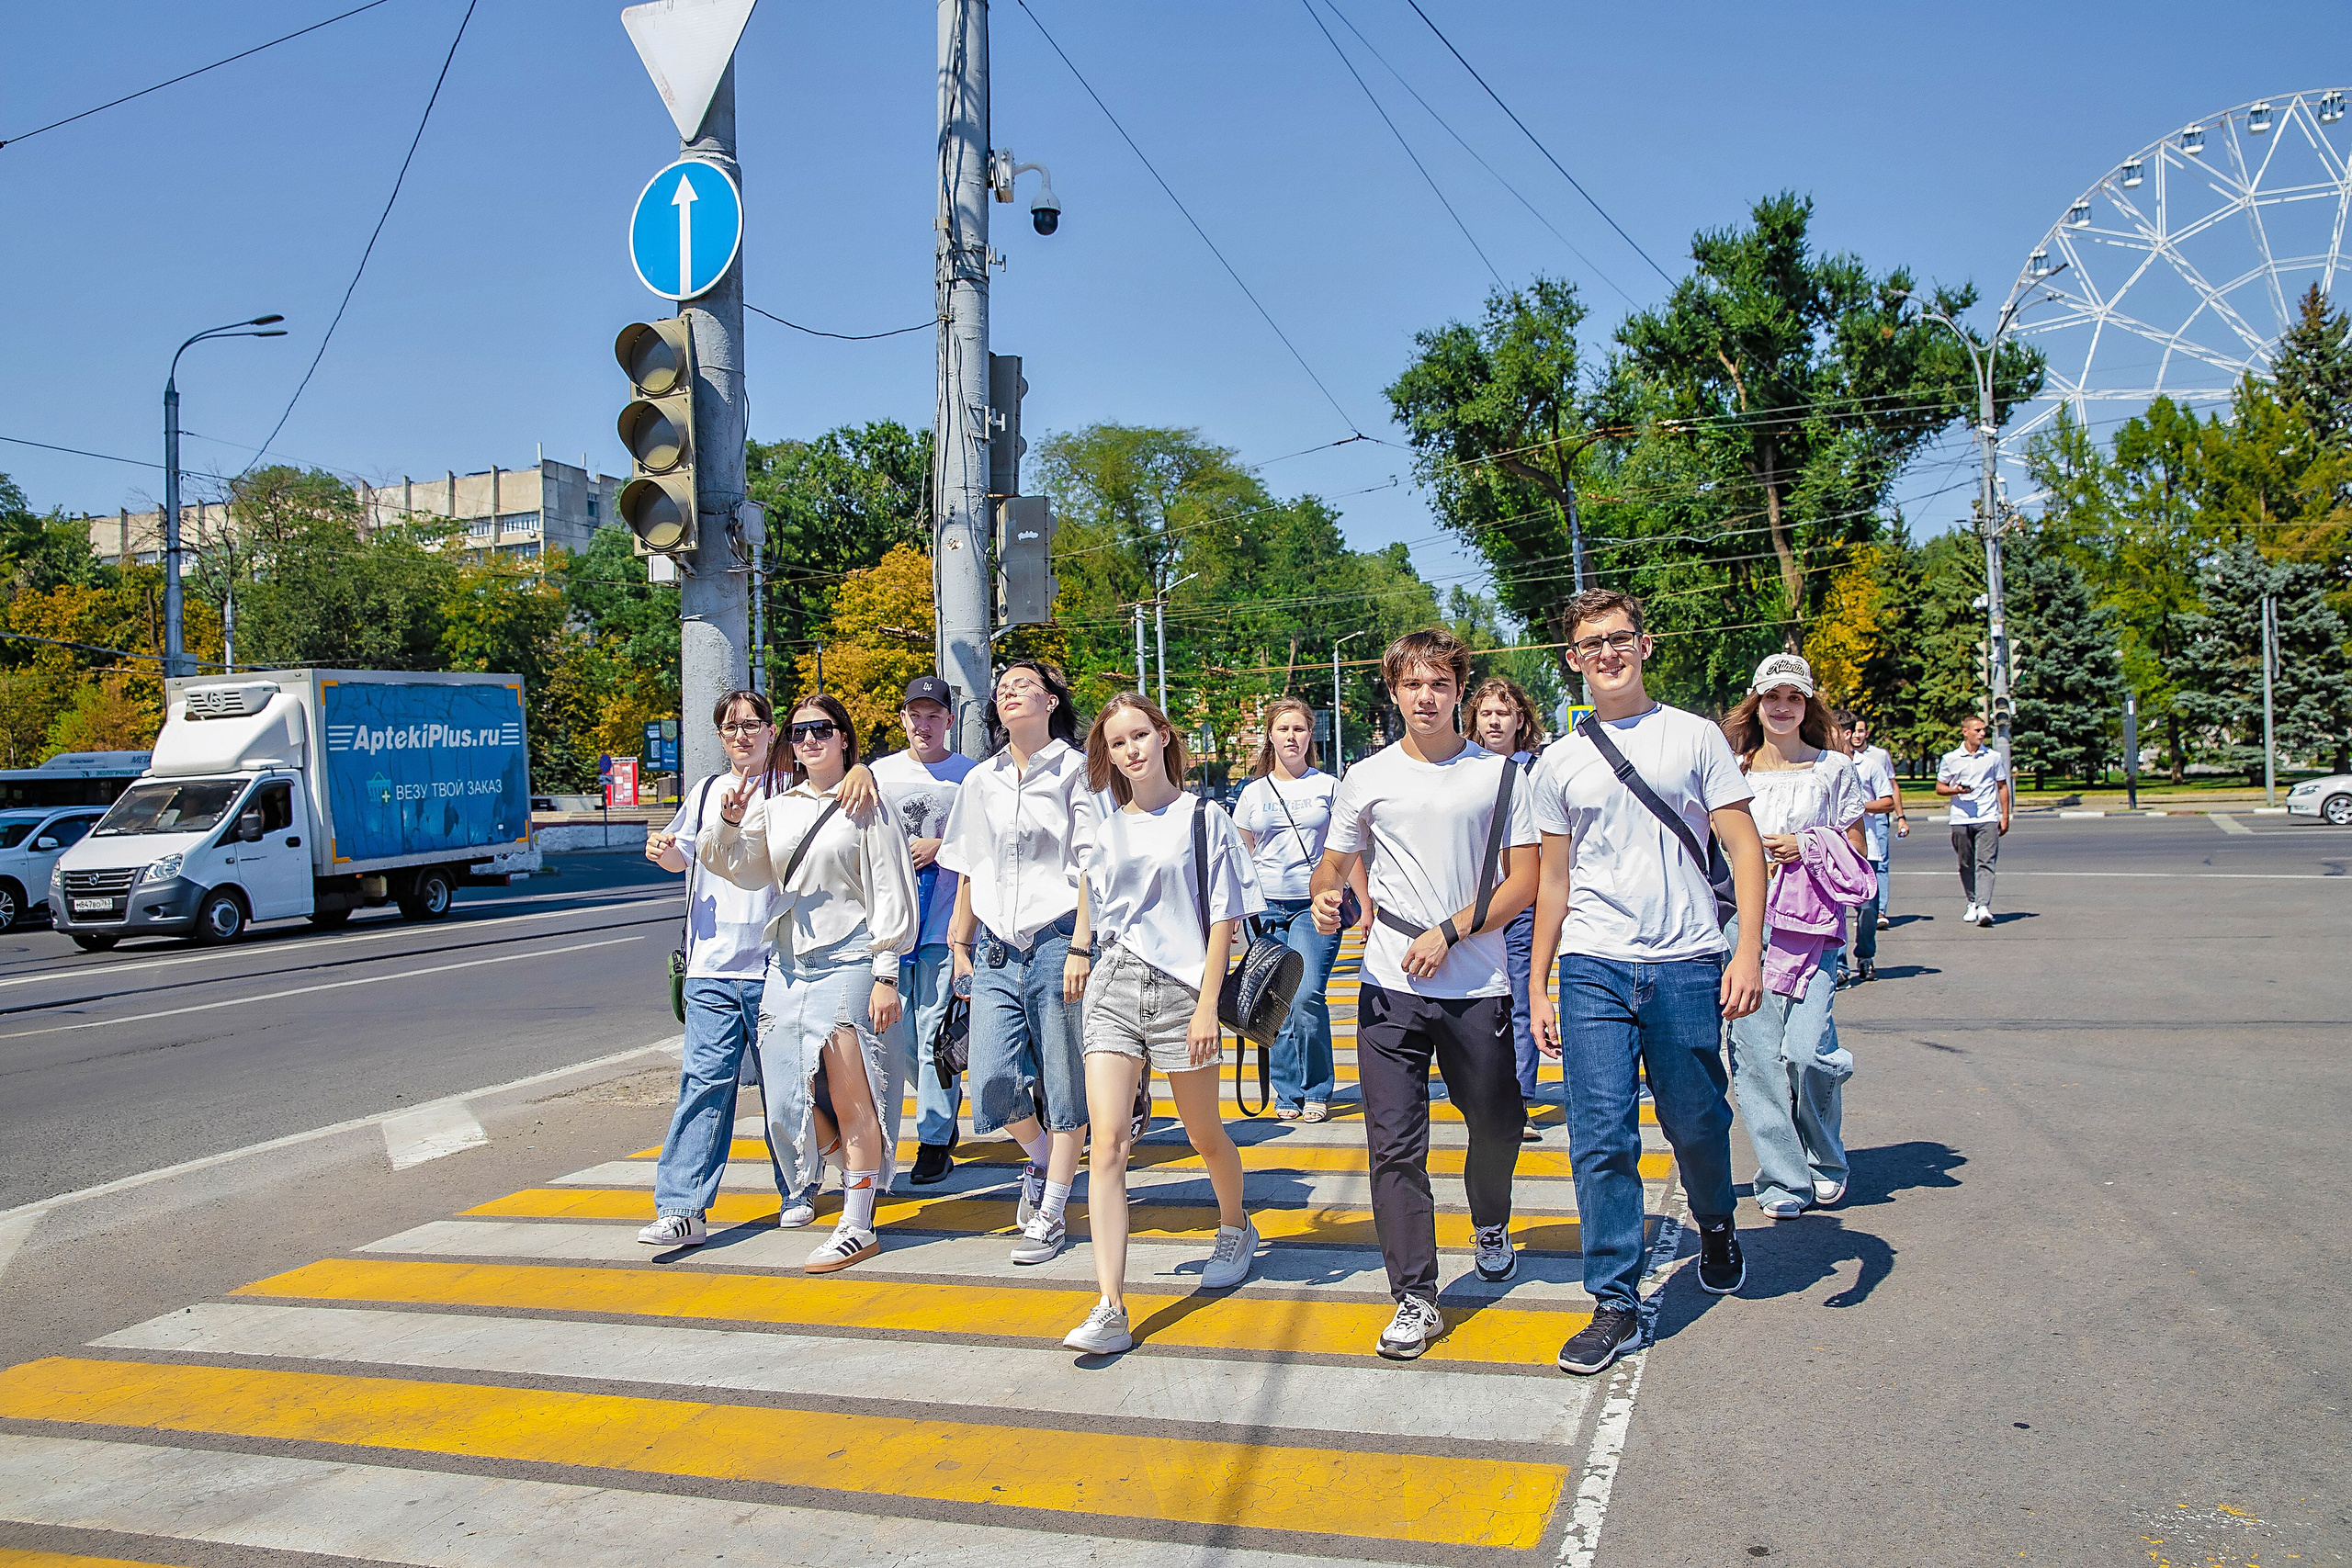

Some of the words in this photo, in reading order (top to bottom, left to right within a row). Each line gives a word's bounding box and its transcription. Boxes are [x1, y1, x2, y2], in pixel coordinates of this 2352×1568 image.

[353, 723, 500, 755] AptekiPlus.ru
[396, 784, 428, 800] ВЕЗУ
[432, 779, 464, 797] ТВОЙ
[467, 779, 503, 795] ЗАКАЗ
